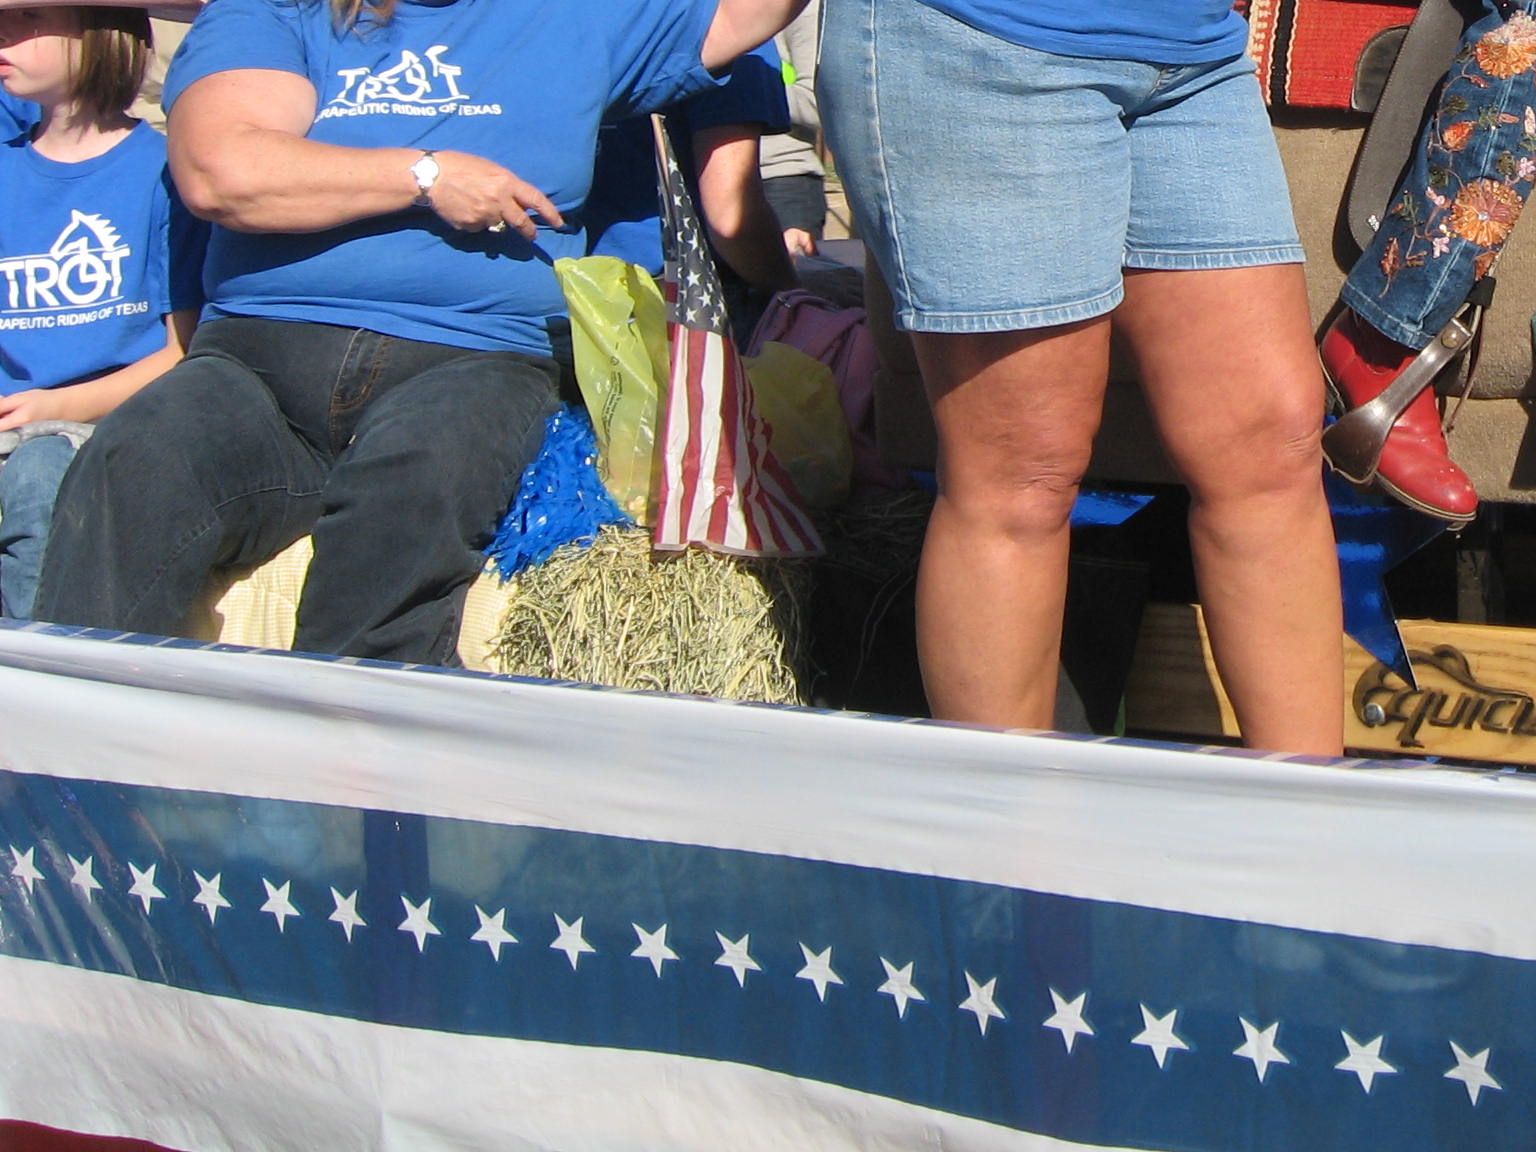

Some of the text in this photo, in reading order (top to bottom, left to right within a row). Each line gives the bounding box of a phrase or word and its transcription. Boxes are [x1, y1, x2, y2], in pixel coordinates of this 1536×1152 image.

[313, 102, 503, 124] RAPEUTIC RIDING OF TEXAS
[0, 300, 149, 330] RAPEUTIC RIDING OF TEXAS
